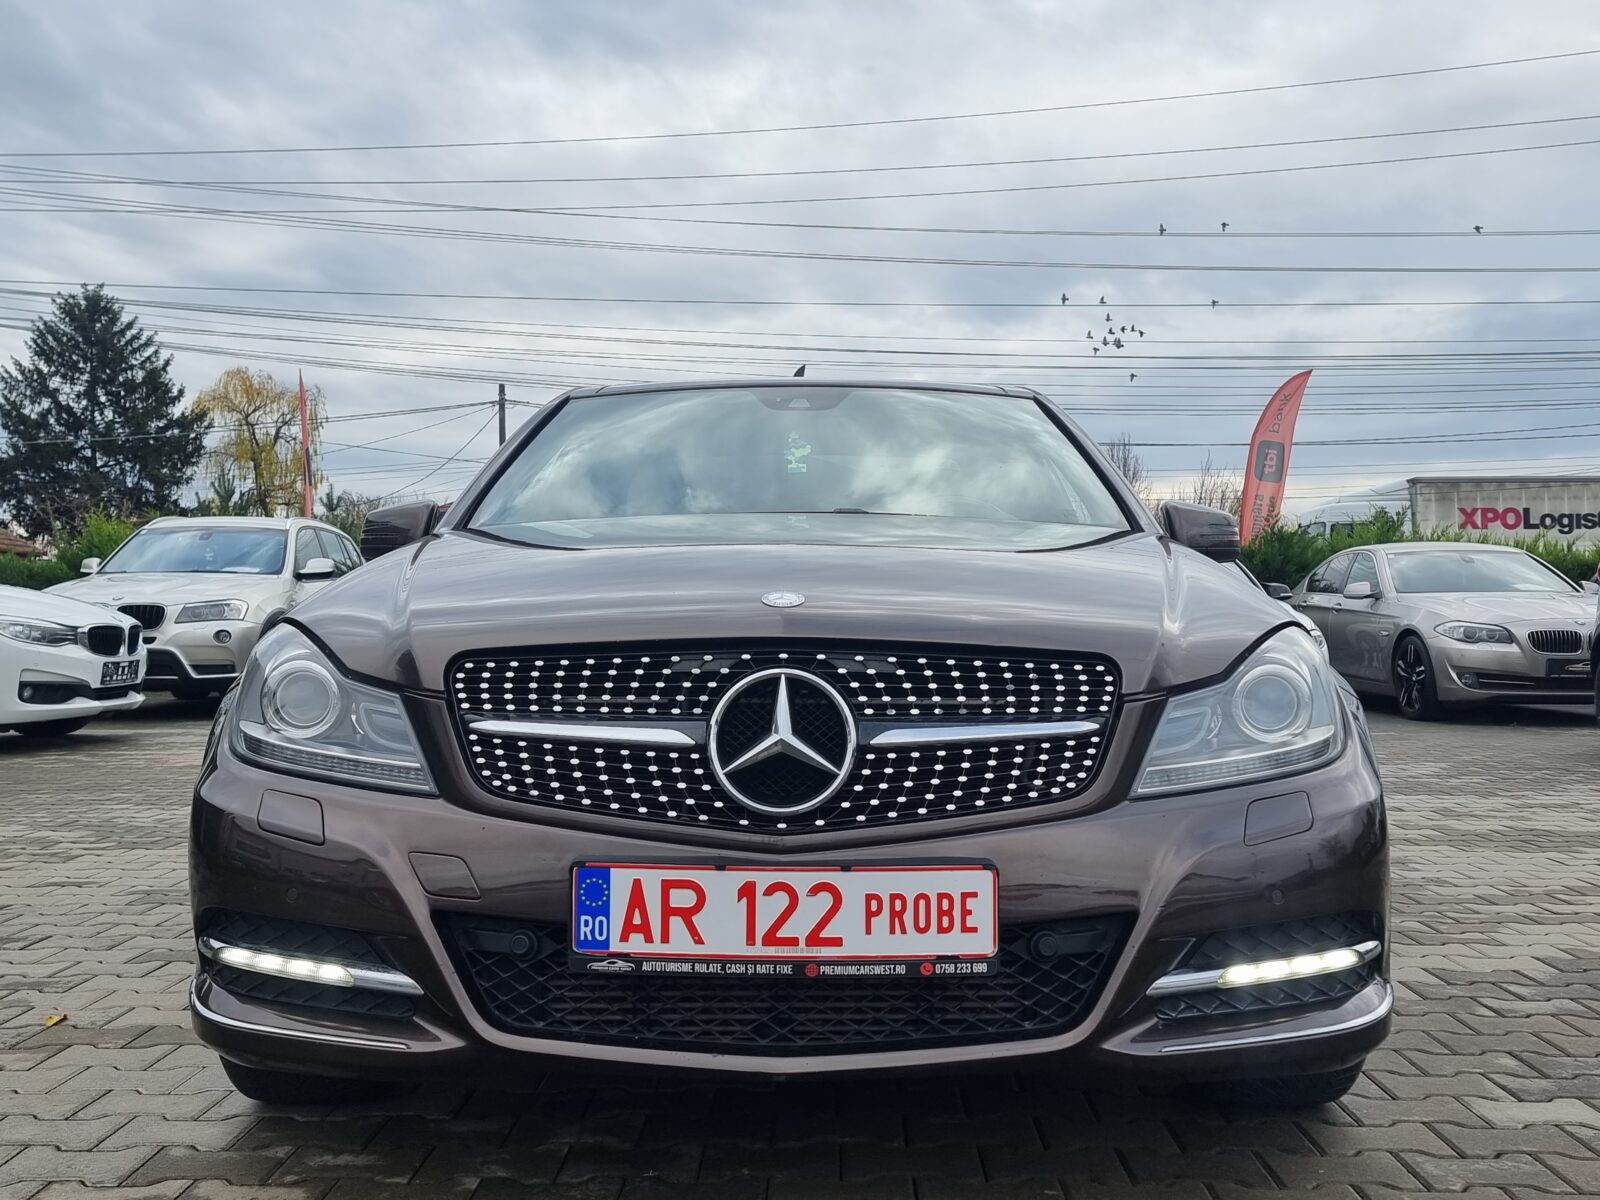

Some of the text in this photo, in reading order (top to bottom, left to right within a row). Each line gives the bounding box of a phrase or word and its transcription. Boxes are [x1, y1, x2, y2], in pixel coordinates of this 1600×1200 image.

[1269, 393, 1292, 434] bank
[1263, 448, 1278, 475] tbi
[1457, 507, 1600, 535] XPOLogis
[618, 877, 980, 948] AR 122 PROBE
[580, 914, 607, 941] RO
[641, 961, 693, 973] AUTOTURISME
[694, 962, 725, 975] RULATE,
[725, 963, 746, 974] CASH
[756, 964, 775, 975] RATE
[776, 964, 793, 975] FIXE
[819, 964, 906, 976] PREMIUMCARSWEST.RO
[935, 962, 988, 974] 0758 233 699
